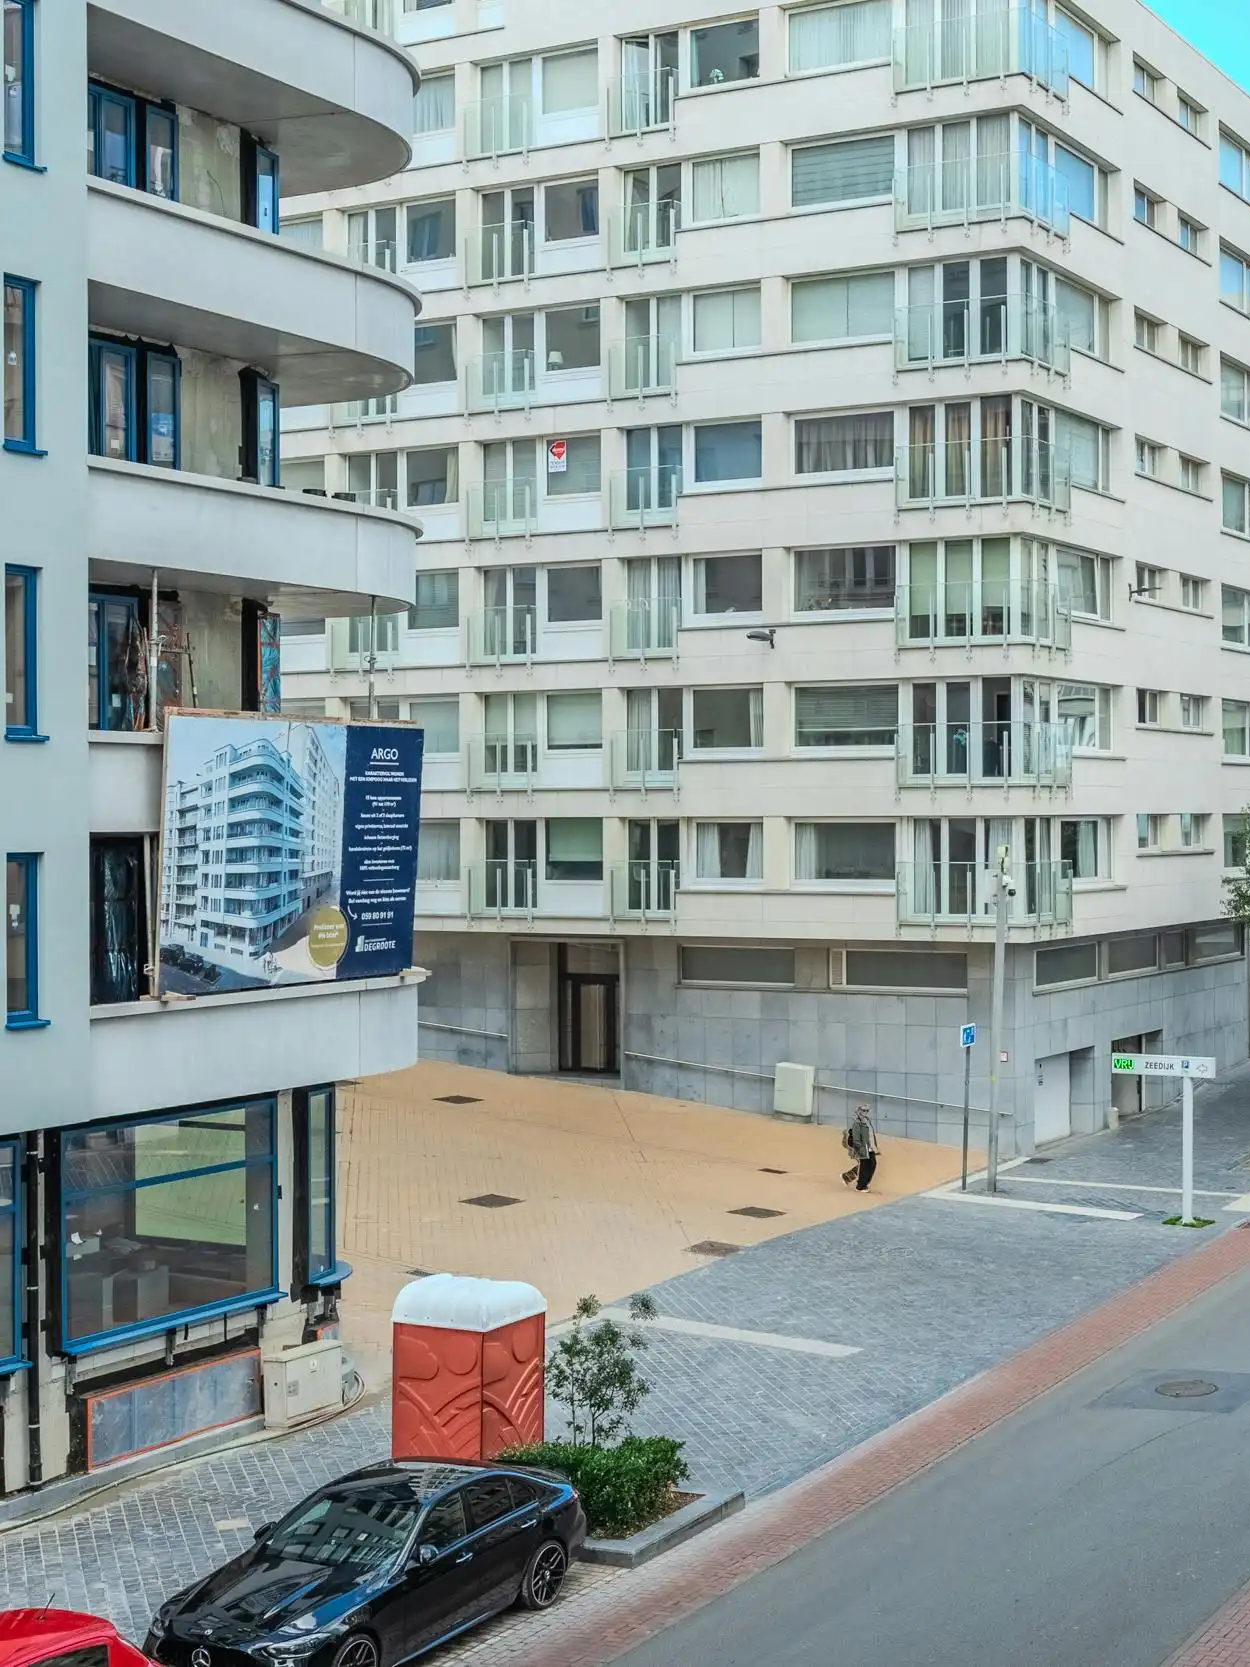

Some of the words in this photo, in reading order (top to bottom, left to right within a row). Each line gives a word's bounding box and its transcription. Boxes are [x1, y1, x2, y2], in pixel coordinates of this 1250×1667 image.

[371, 748, 399, 760] ARGO
[364, 940, 396, 952] DEGROOTE
[1144, 1061, 1174, 1070] ZEEDIJK
